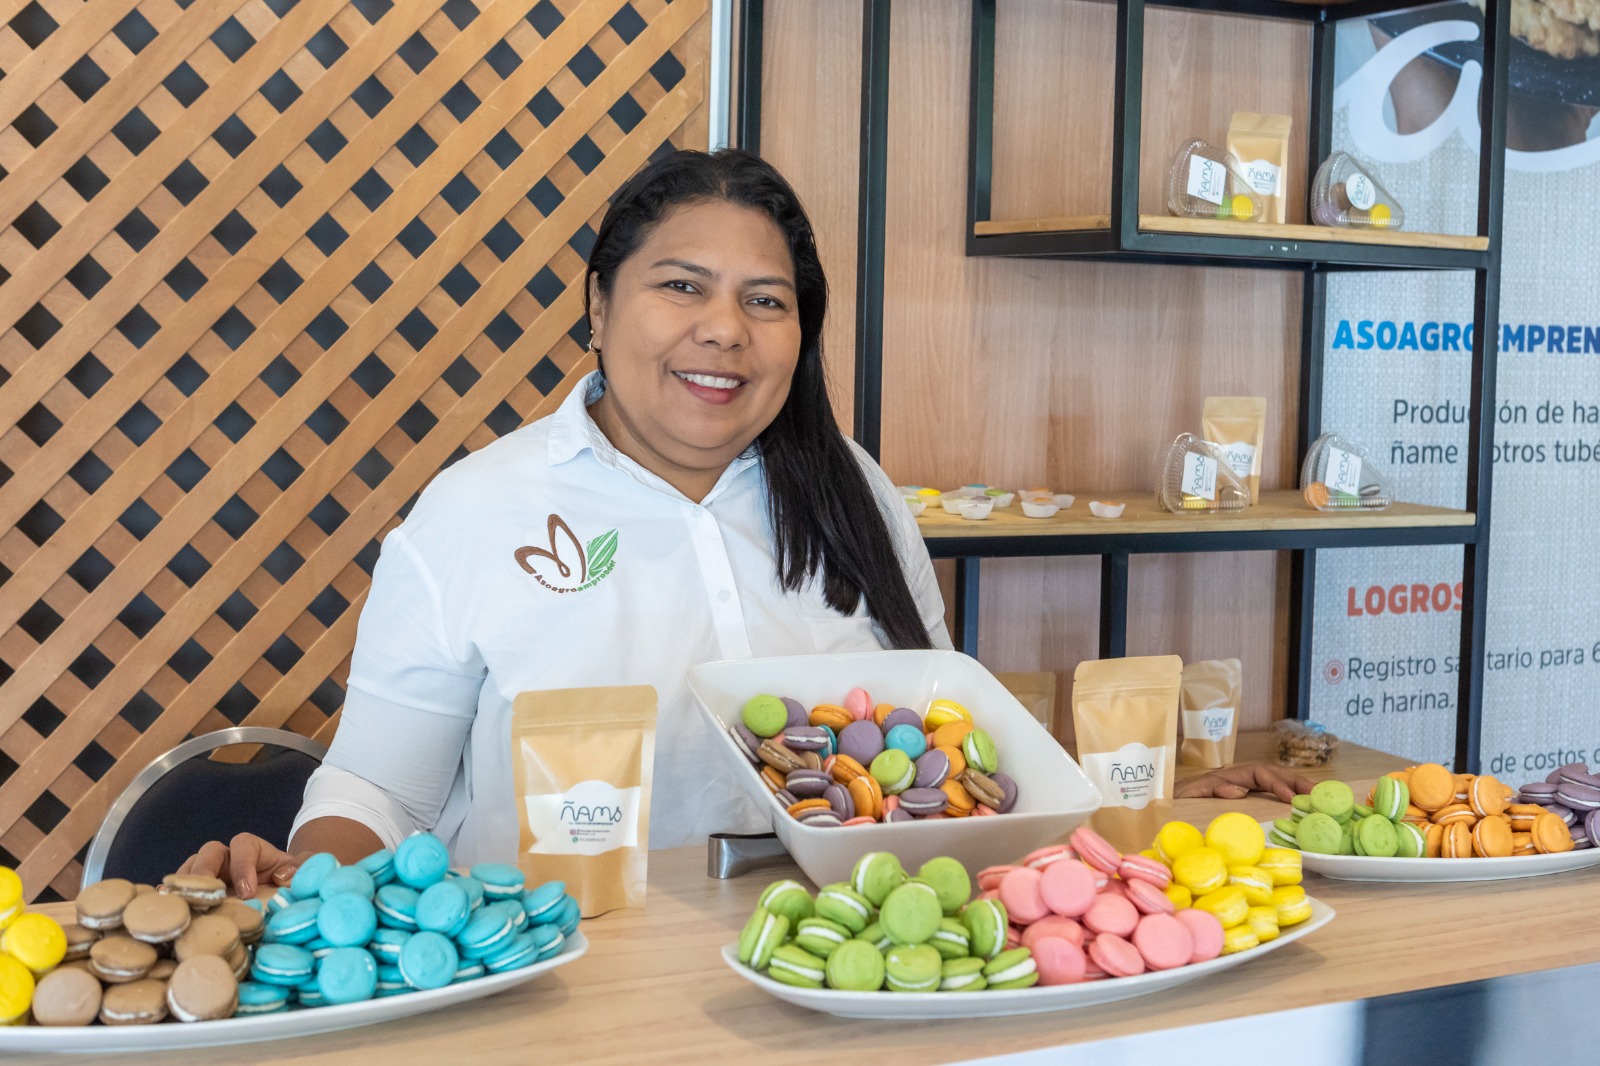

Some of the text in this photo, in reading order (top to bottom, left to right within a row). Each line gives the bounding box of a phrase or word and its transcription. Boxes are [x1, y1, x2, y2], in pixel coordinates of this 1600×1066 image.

[1332, 320, 1600, 354] ASOAGROMPREN
[1536, 399, 1564, 424] de
[1573, 400, 1599, 424] ha
[1391, 440, 1458, 464] ñame
[1493, 441, 1546, 463] otros
[1347, 582, 1463, 617] LOGROS
[1348, 655, 1436, 681] Registro
[1444, 647, 1533, 674] satario
[1540, 648, 1585, 669] para
[1346, 690, 1454, 717] de harina.
[1490, 752, 1517, 774] de
[1524, 748, 1586, 771] costos
